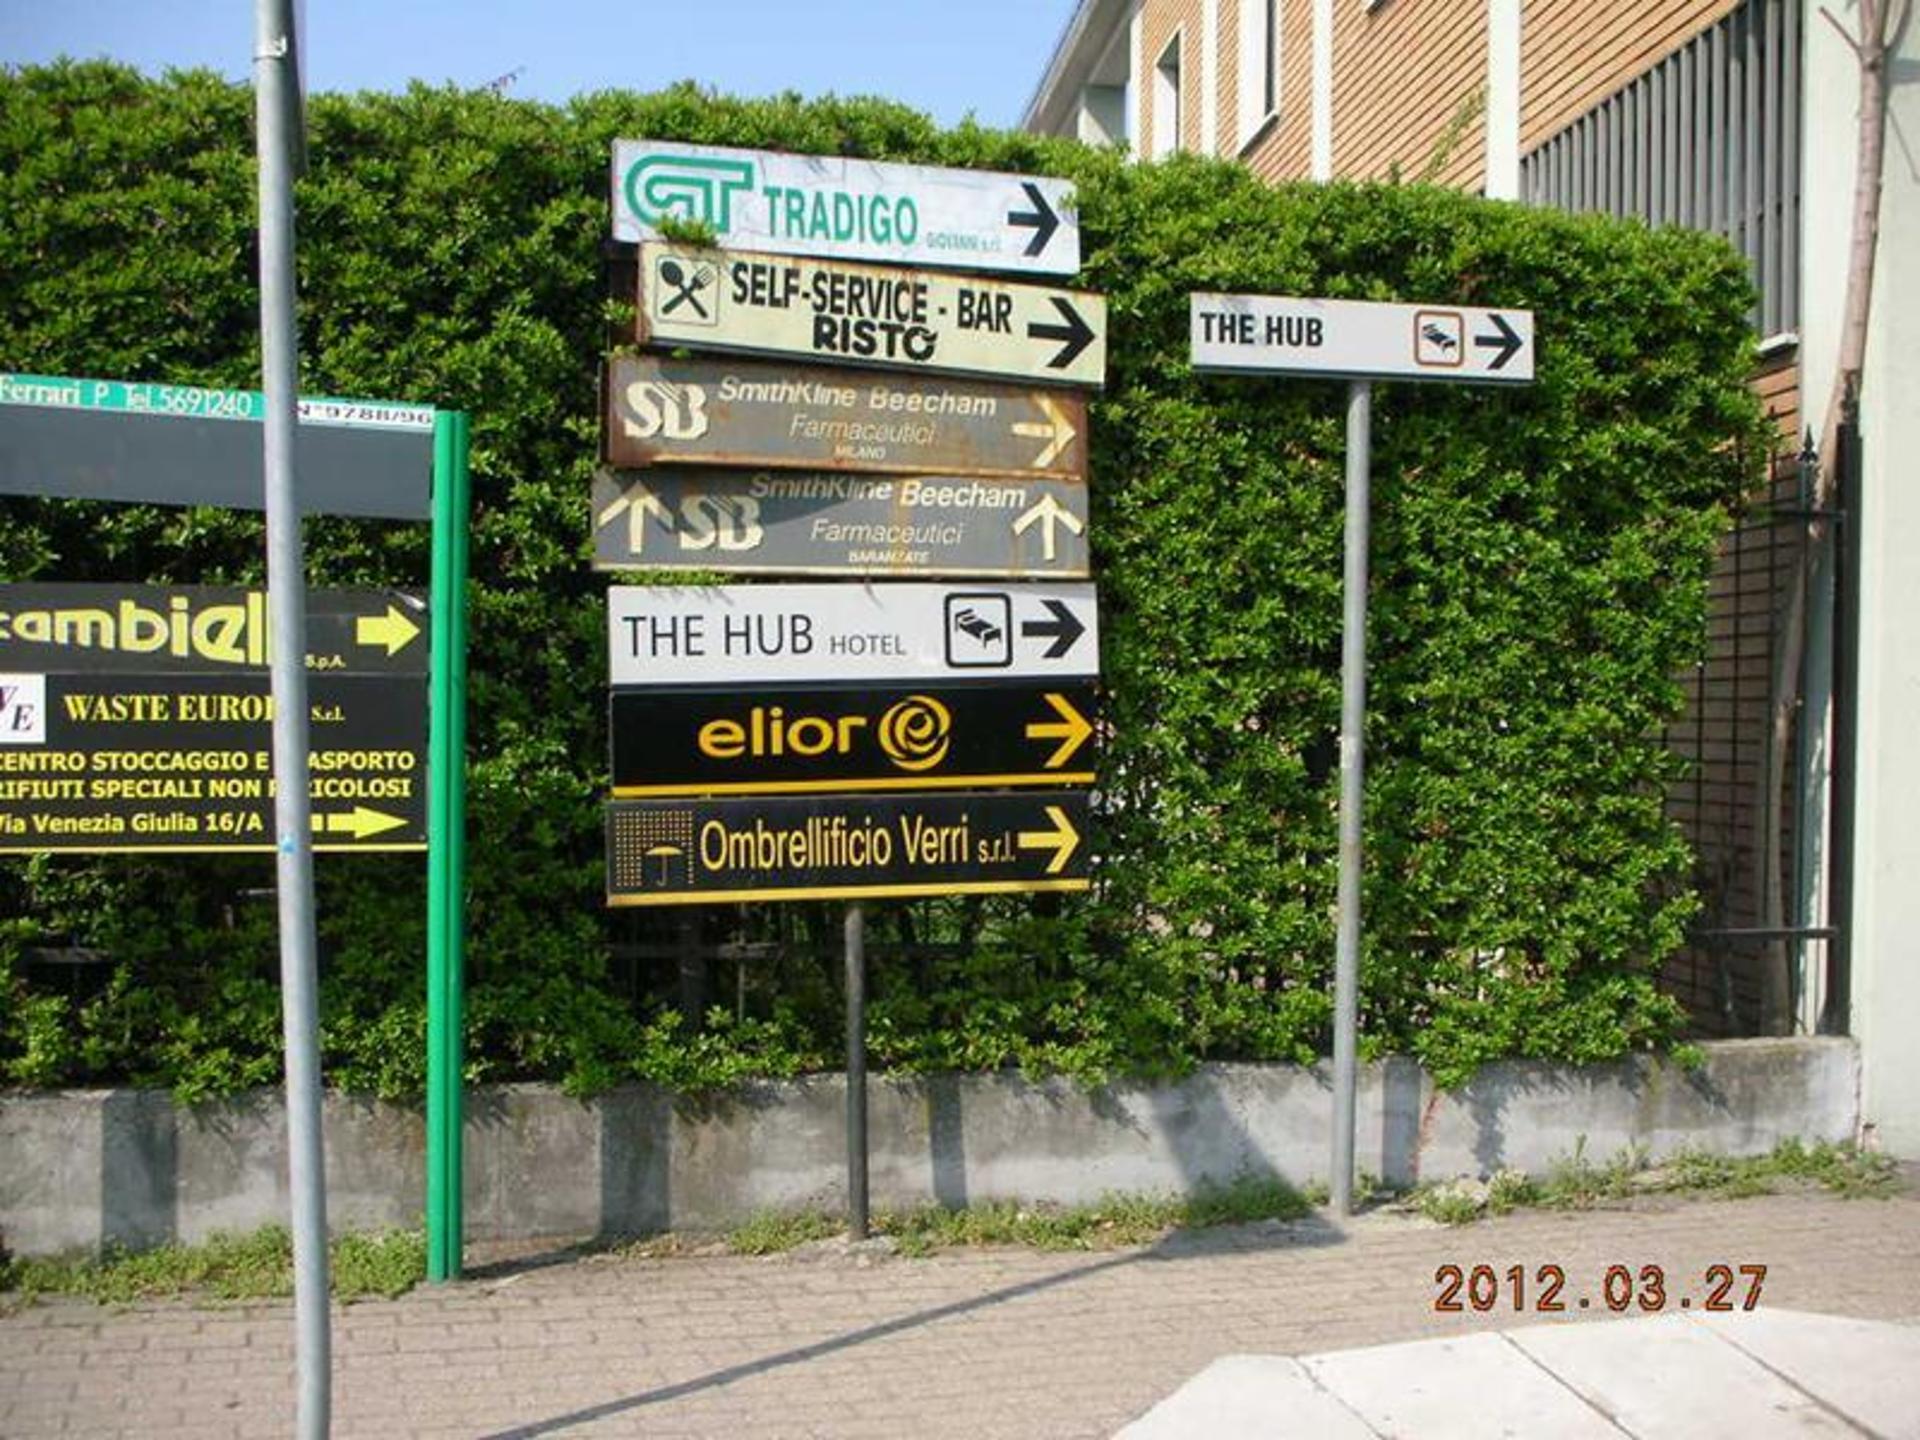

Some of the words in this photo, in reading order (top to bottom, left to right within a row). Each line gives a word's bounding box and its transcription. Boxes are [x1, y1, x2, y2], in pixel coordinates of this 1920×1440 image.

[763, 186, 918, 246] TRADIGO
[732, 262, 927, 323] SELF-SERVICE
[958, 289, 1012, 333] BAR
[1201, 312, 1255, 345] THE
[1265, 315, 1323, 347] HUB
[625, 381, 708, 440] SB
[719, 376, 856, 408] SmithKline
[870, 387, 996, 417] Beecham
[790, 414, 936, 445] Farmaceutici
[751, 475, 891, 501] SmithKline
[900, 479, 1026, 509] Beecham
[680, 495, 763, 551] SB
[811, 520, 963, 546] Farmaceutici
[623, 615, 705, 658] THE
[724, 614, 813, 657] HUB
[831, 634, 906, 656] HOTEL
[64, 694, 169, 721] WASTE
[698, 707, 866, 759] elior
[0, 752, 86, 771] ENTRO
[92, 752, 247, 771] STOCCAGGIO
[256, 753, 269, 770] E
[307, 751, 415, 770] ASPORTO
[90, 779, 203, 798] SPECIALI
[209, 778, 261, 798] NON
[32, 814, 124, 833] Venezia
[131, 813, 197, 832] Giulia
[207, 813, 263, 834] 16/A
[701, 815, 891, 871] Ombrellificio
[901, 814, 968, 864] Verri
